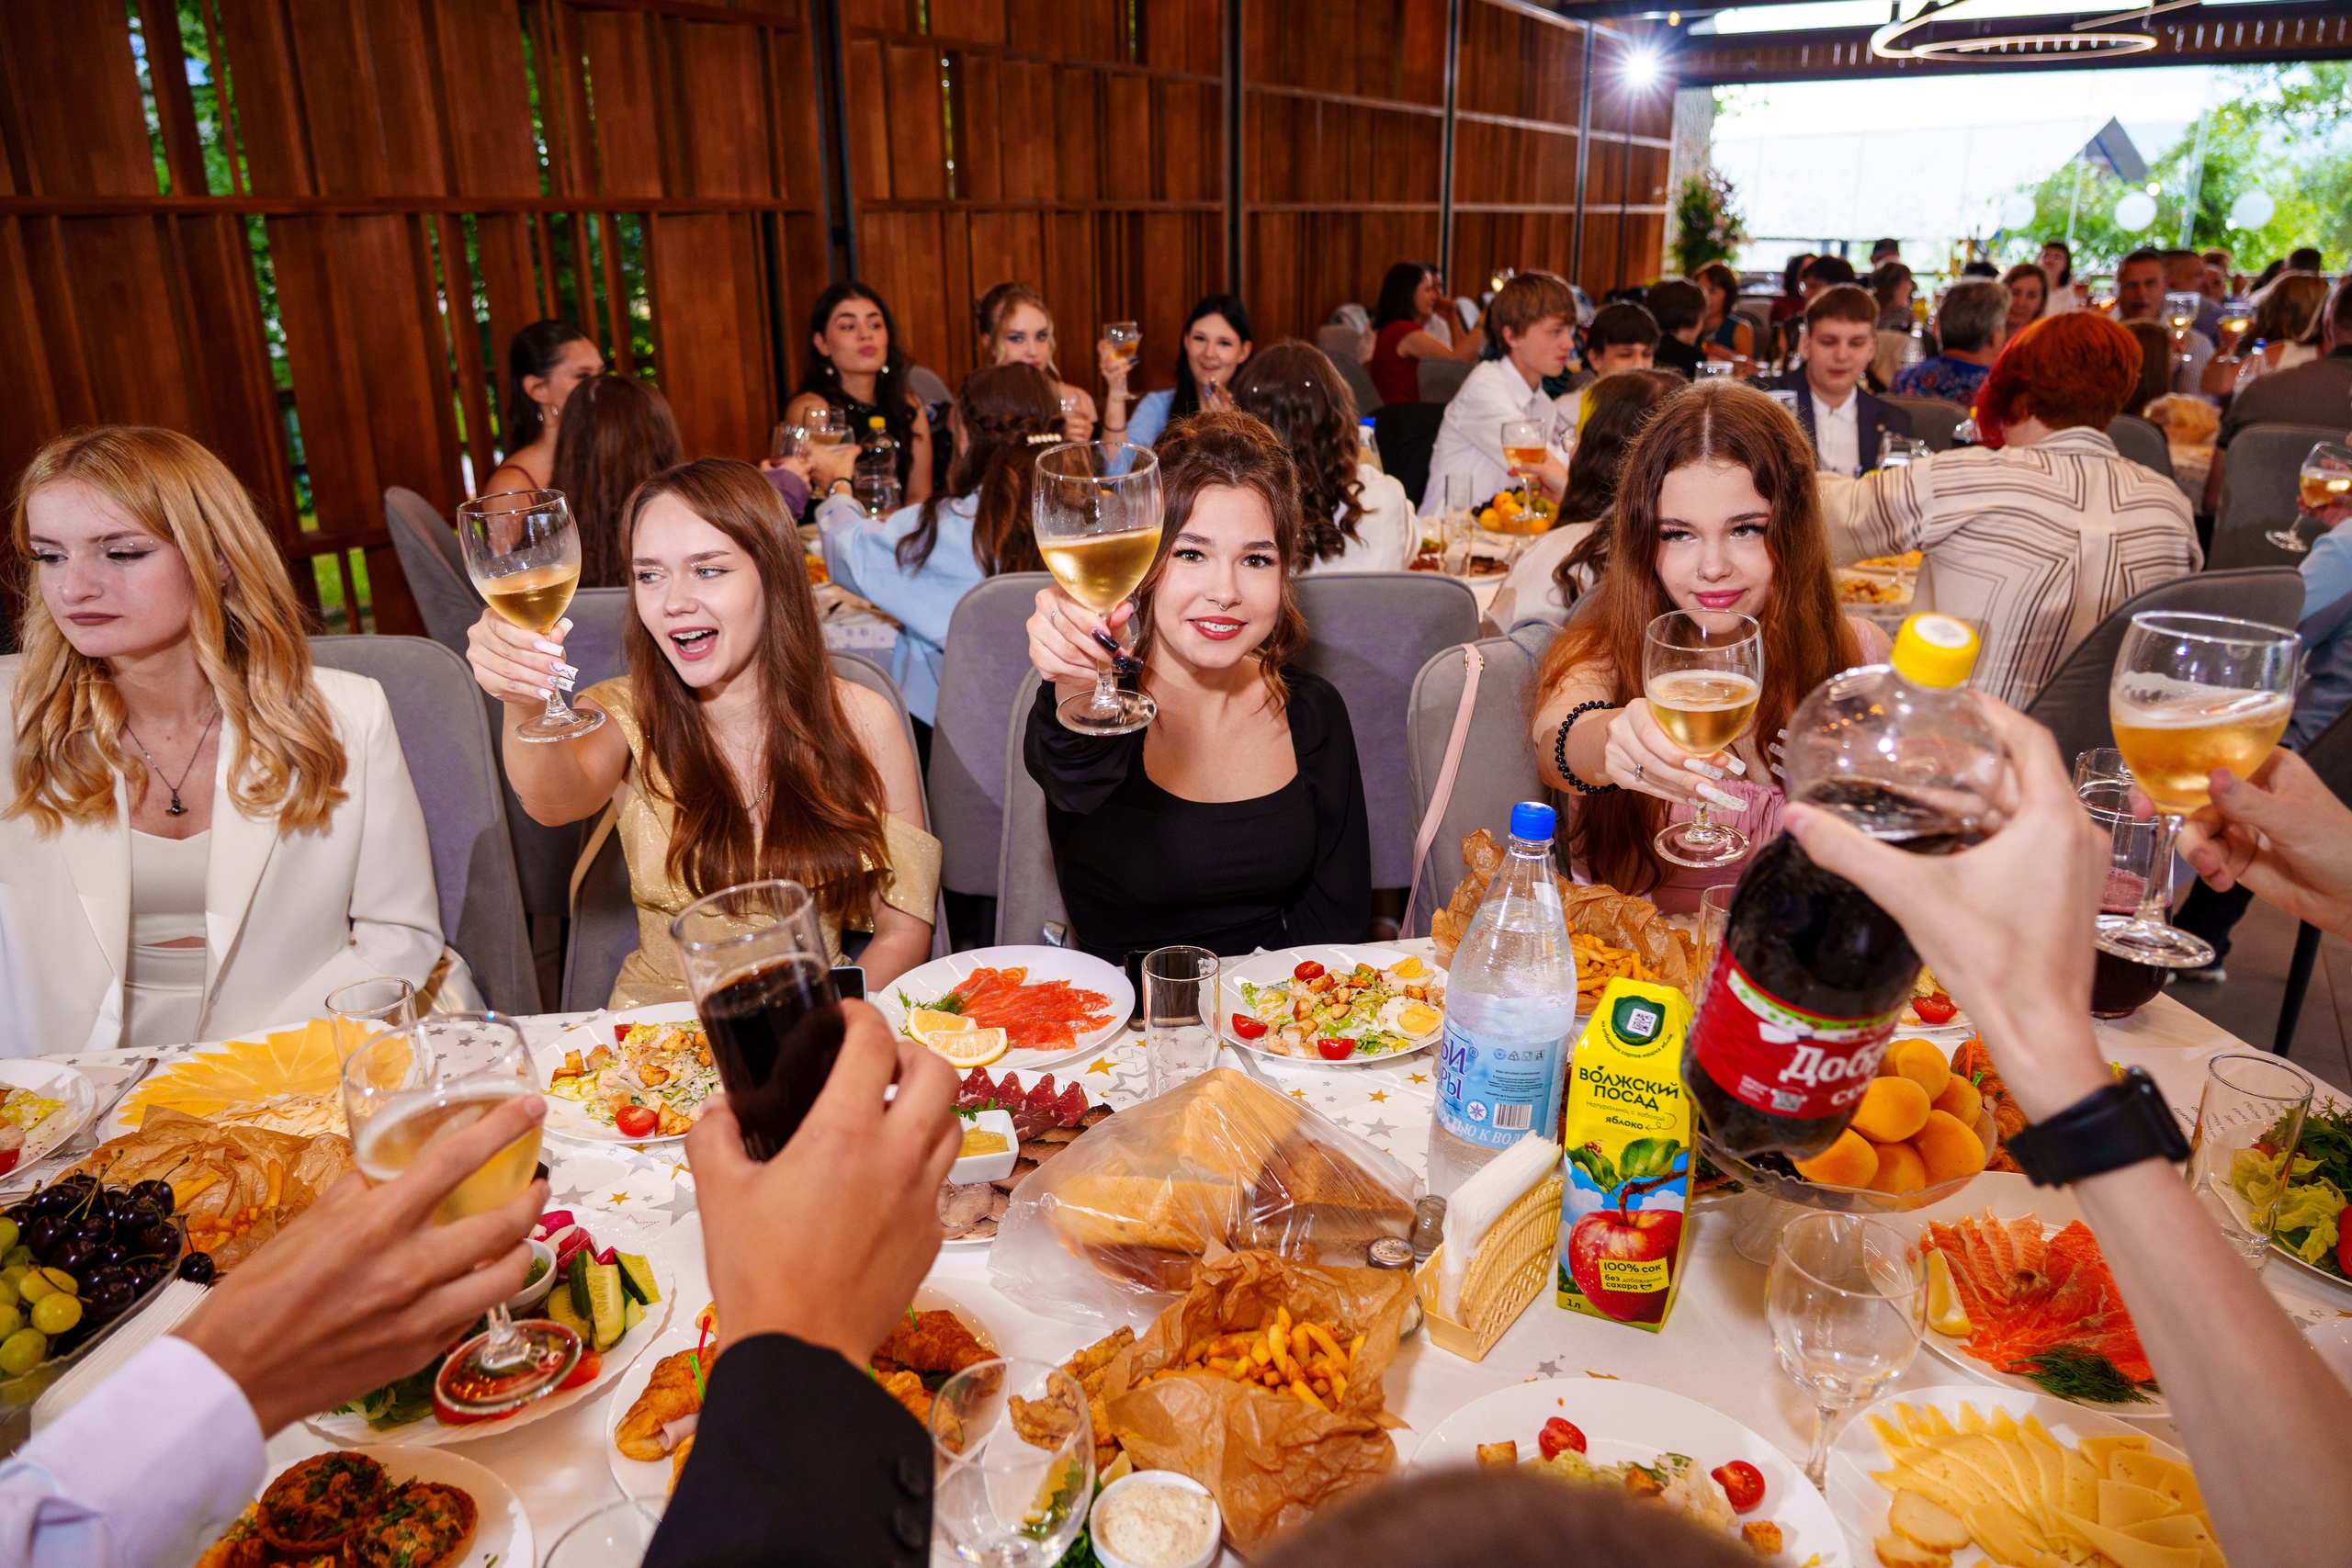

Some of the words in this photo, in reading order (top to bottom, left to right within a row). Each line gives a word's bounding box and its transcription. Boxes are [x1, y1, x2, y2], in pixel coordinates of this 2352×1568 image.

[1602, 1029, 1621, 1053] отборных
[1621, 1050, 1642, 1059] сортов
[1643, 1048, 1662, 1058] наших
[1661, 1033, 1674, 1049] яблок
[1579, 1066, 1679, 1100] ВОЛЖСКИЙ
[1594, 1084, 1659, 1112] ПОСАД
[1587, 1100, 1630, 1115] Натурально,
[1636, 1111, 1666, 1122] заботой
[1605, 1115, 1644, 1130] яблоко
[1478, 1128, 1491, 1142] К
[1491, 1131, 1527, 1147] ВОД
[1603, 1262, 1639, 1273] 100%
[1642, 1264, 1662, 1273] сок
[1566, 1298, 1581, 1310] 1л
